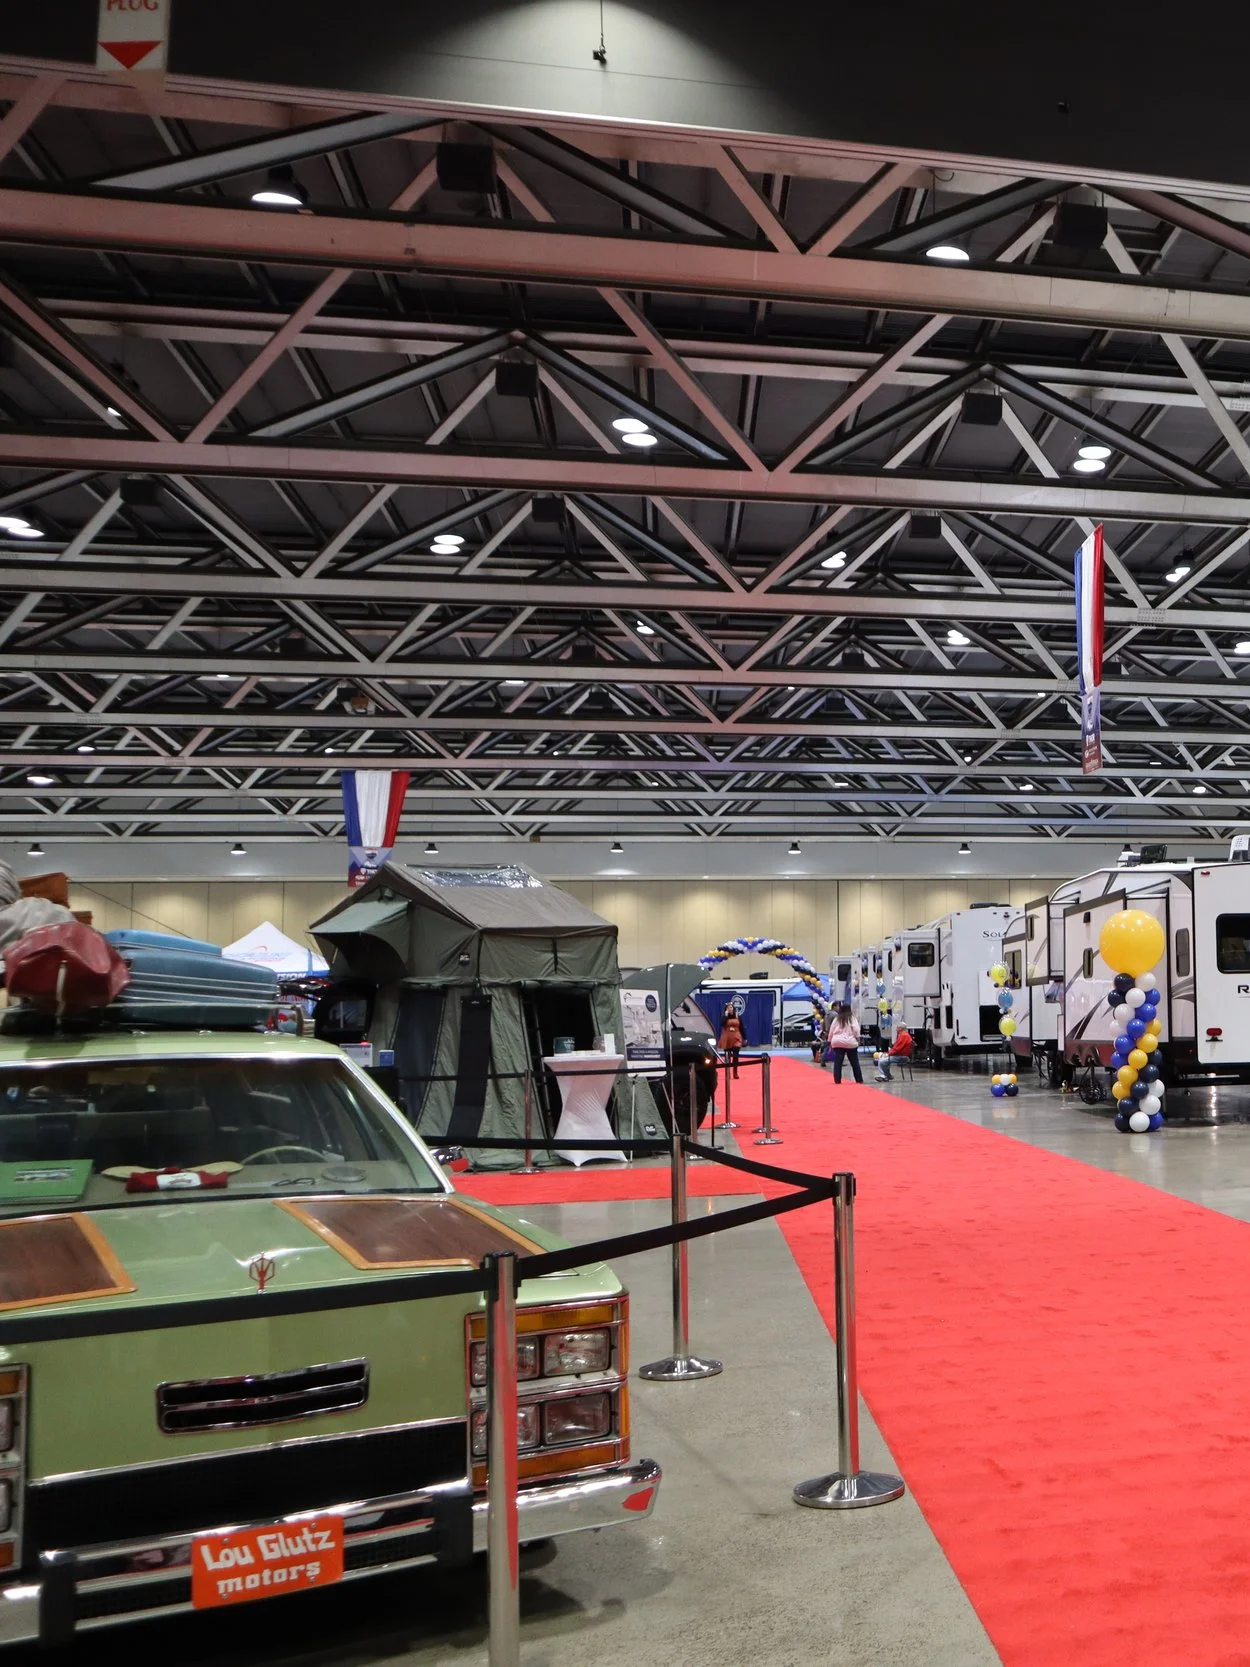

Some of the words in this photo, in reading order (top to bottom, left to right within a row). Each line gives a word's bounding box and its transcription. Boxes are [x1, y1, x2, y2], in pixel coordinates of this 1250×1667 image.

[200, 1544, 255, 1571] Lou
[257, 1527, 336, 1561] Glutz
[217, 1561, 321, 1594] motors
